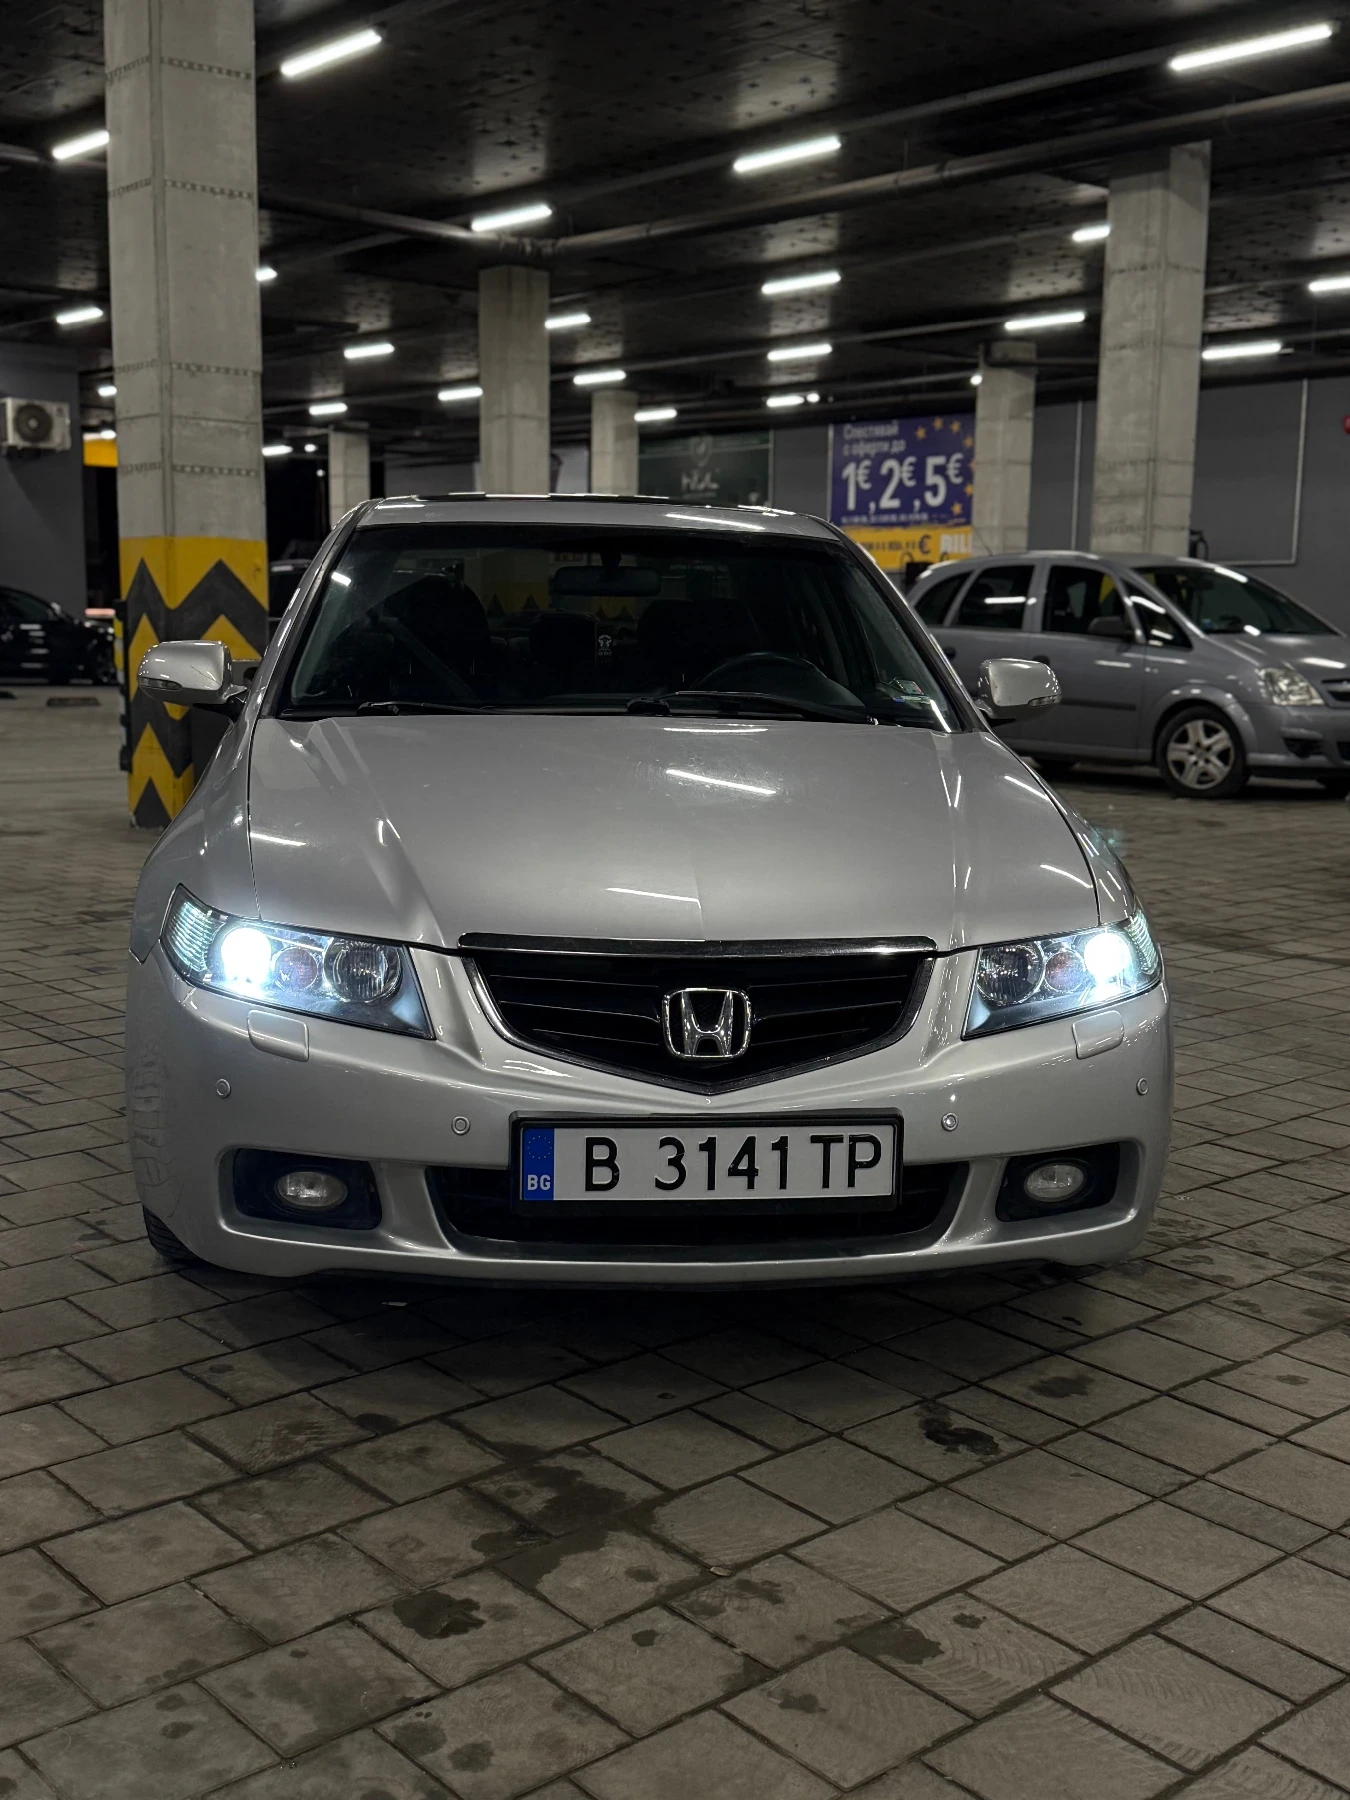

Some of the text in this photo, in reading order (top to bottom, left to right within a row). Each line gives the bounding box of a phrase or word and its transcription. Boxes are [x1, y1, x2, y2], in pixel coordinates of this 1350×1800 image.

[585, 1134, 882, 1192] B 3141 TP
[527, 1174, 551, 1191] BG
